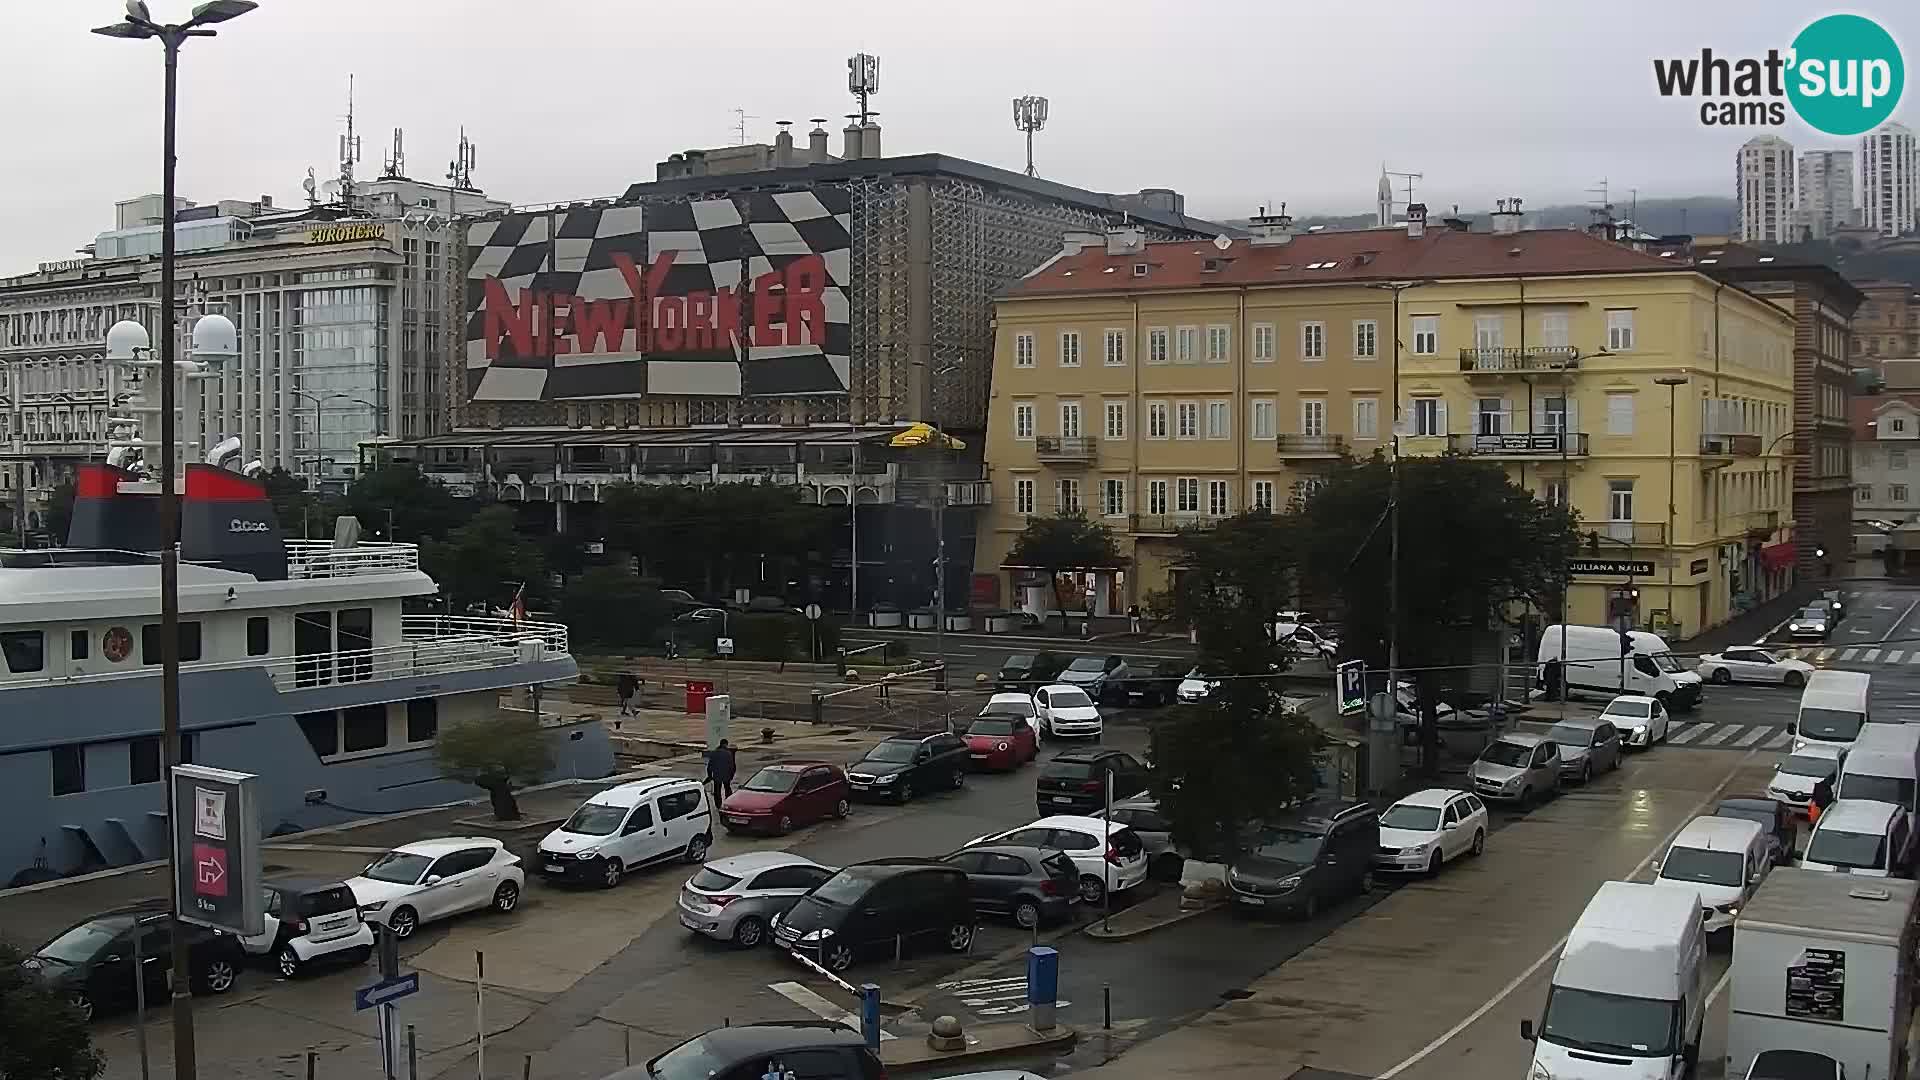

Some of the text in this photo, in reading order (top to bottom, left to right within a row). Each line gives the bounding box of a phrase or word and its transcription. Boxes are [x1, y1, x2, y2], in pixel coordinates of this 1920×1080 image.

[609, 249, 826, 352] YORKER
[1570, 563, 1649, 572] JULIANA NAILS
